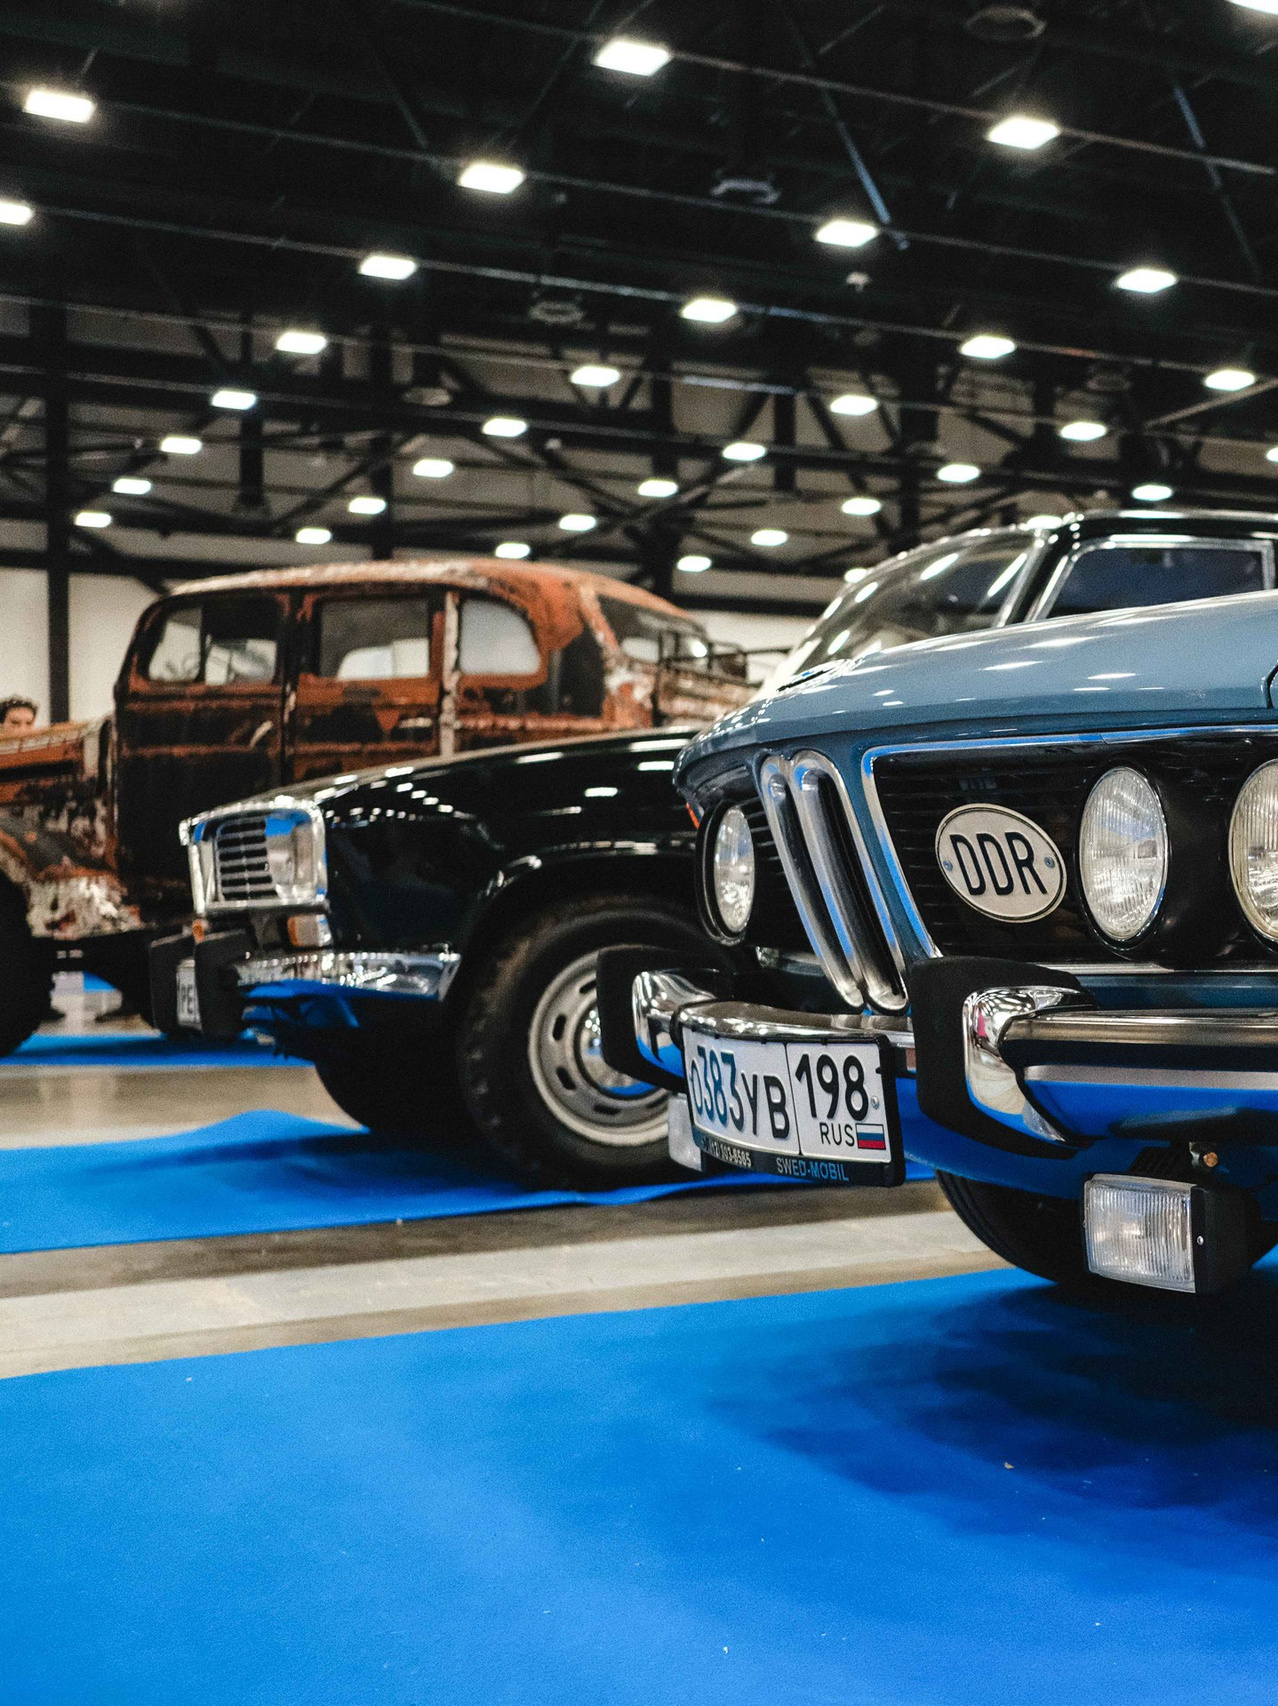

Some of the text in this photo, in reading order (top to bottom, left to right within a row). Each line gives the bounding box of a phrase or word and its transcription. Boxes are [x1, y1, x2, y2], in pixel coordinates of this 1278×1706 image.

[950, 831, 1048, 895] DDR
[795, 1053, 869, 1121] 198
[819, 1122, 855, 1147] RUS
[776, 1157, 849, 1181] SWED-MOBIL
